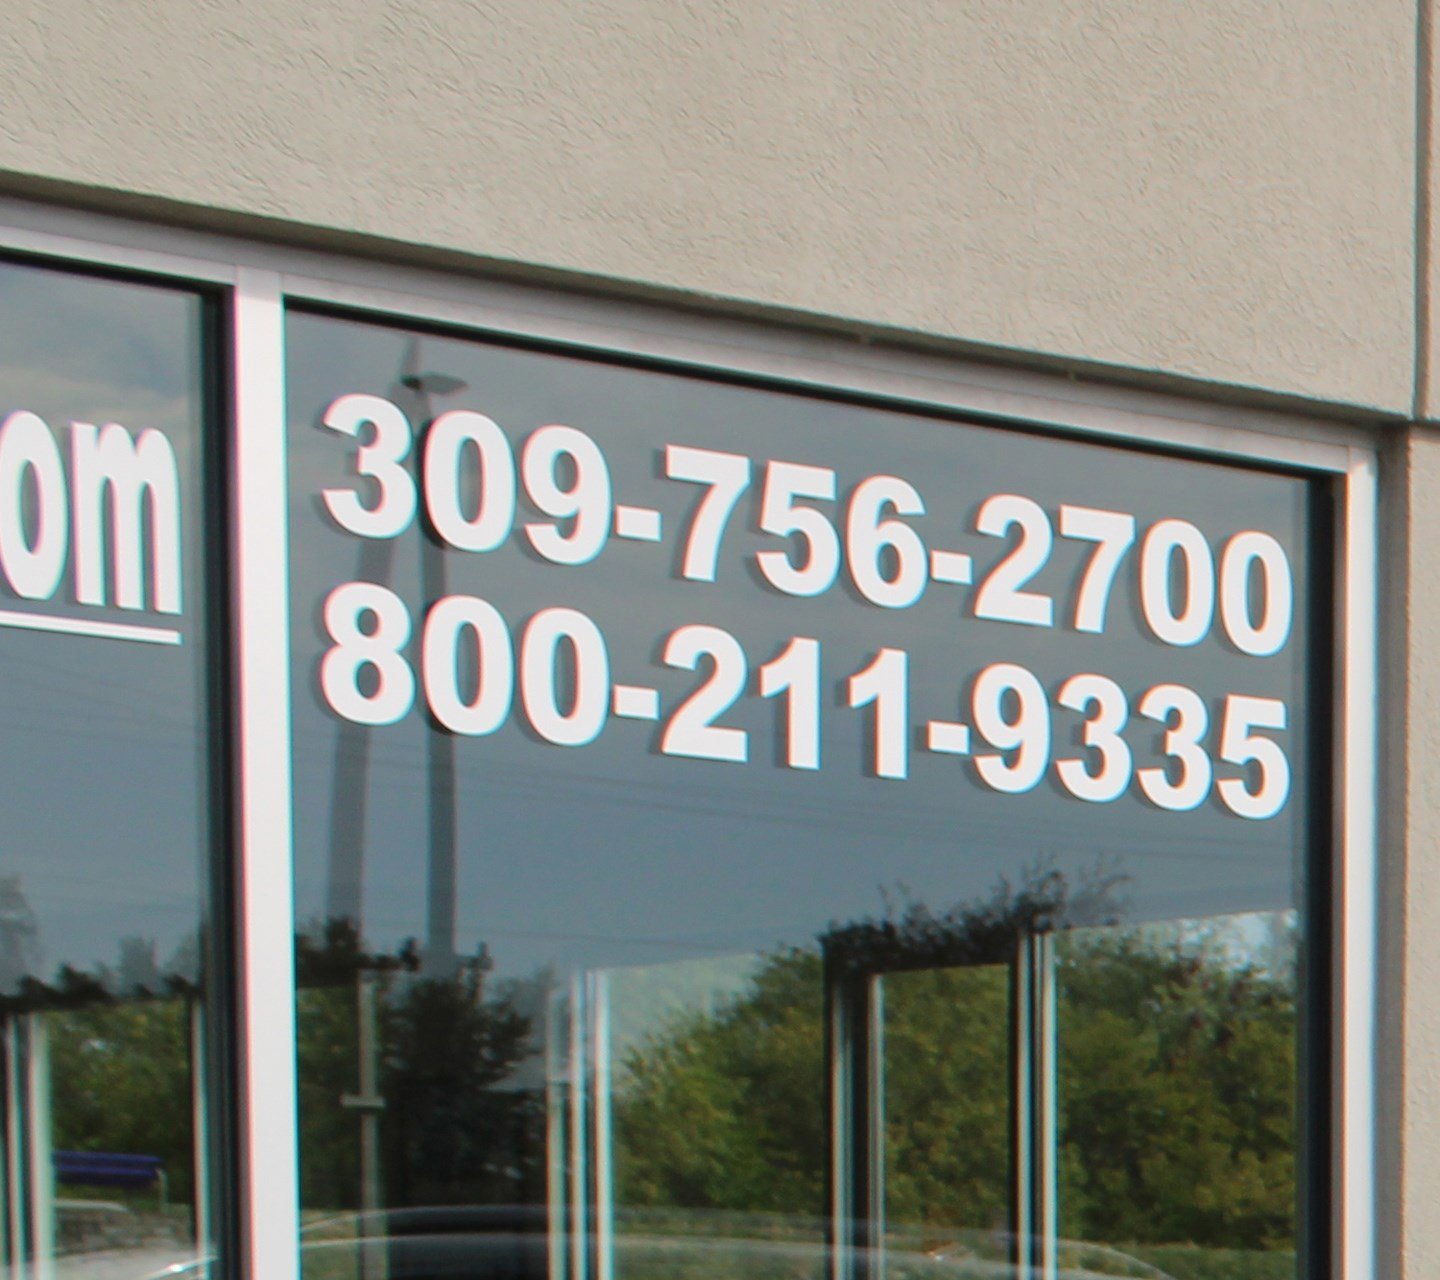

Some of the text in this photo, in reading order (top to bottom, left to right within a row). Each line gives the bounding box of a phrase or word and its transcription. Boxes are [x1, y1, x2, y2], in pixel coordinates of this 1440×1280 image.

[0, 409, 184, 614] om
[322, 394, 1294, 656] 309-756-2700
[320, 582, 1291, 819] 800-211-9335
